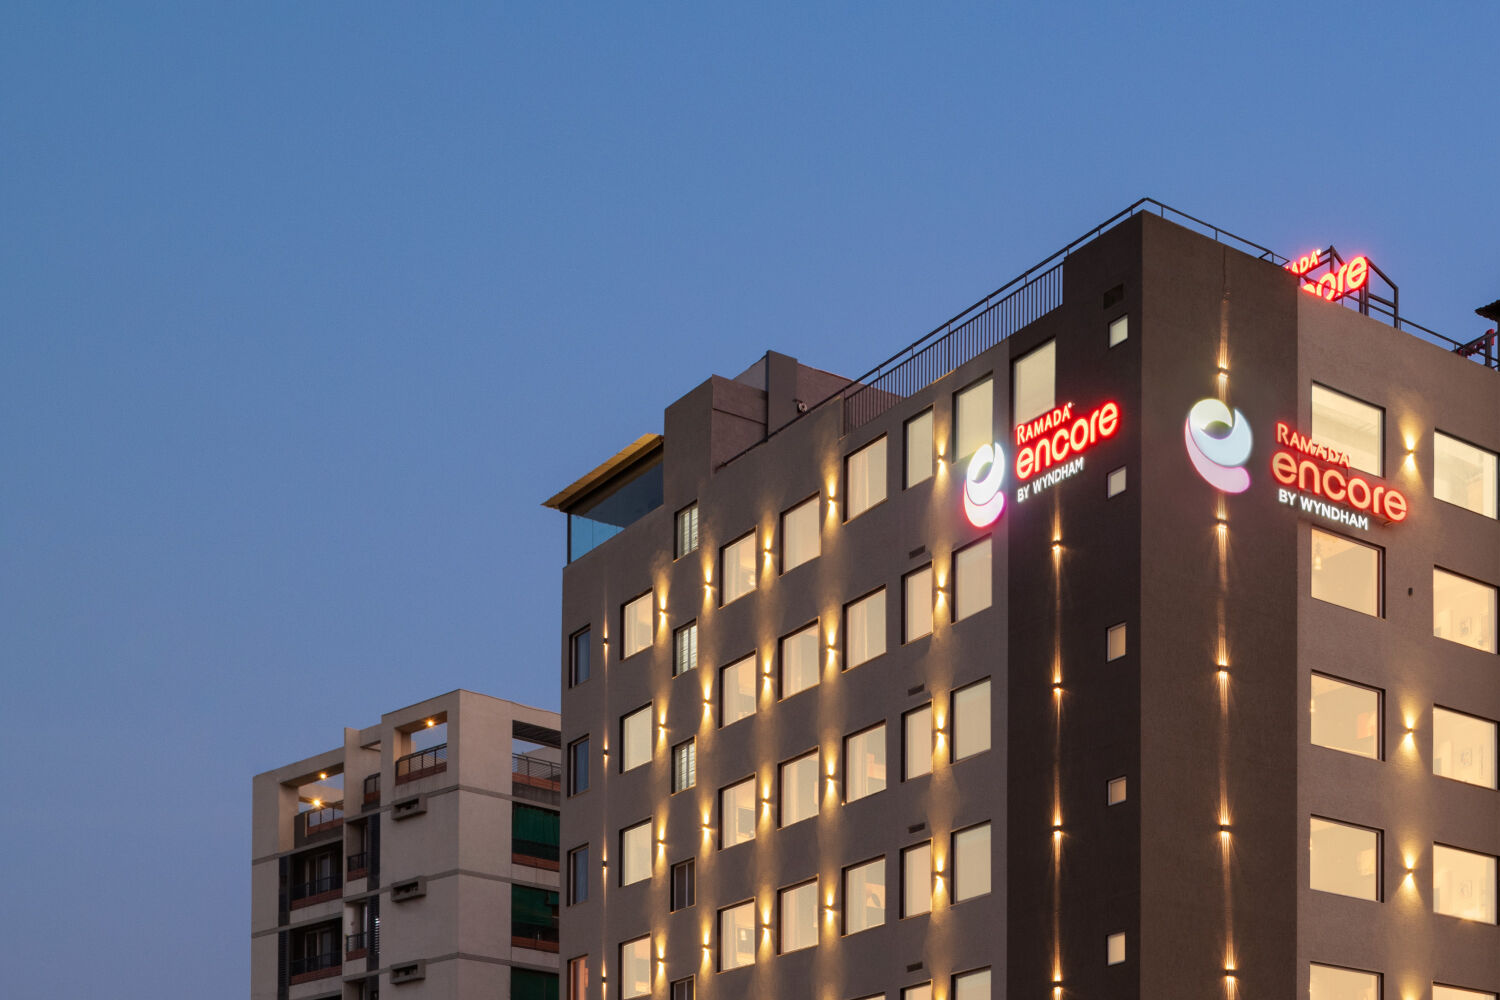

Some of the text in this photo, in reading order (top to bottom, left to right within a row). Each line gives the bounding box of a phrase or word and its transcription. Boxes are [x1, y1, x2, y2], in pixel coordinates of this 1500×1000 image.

[1016, 405, 1071, 446] RAMADA
[1016, 402, 1118, 479] encore
[1276, 422, 1350, 467] RAMADA
[1017, 456, 1085, 503] BY WYNDHAM
[1272, 451, 1407, 521] encore
[1279, 489, 1368, 530] BY WYNDHAM
